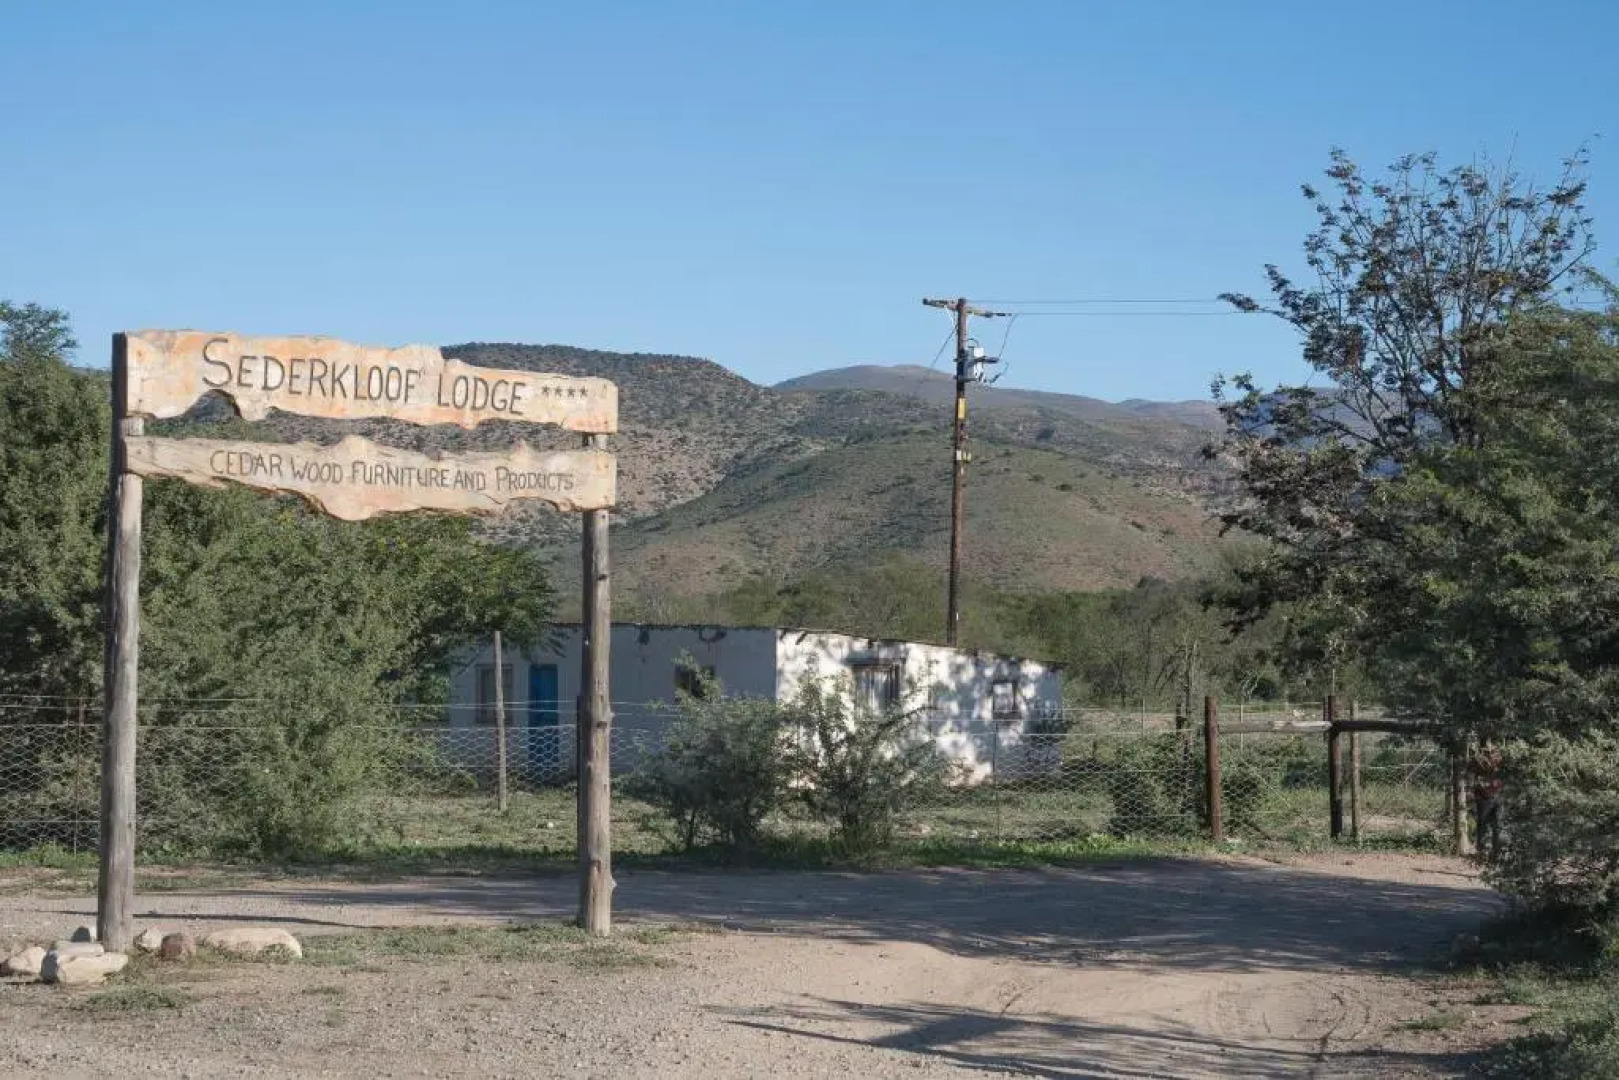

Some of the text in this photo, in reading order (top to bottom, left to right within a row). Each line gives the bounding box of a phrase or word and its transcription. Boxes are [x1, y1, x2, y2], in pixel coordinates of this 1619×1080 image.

[202, 338, 526, 415] SEDERKLOOF LODGE
[209, 450, 575, 491] CEDAR WOOD FURNITURE AND PRODUCTS
